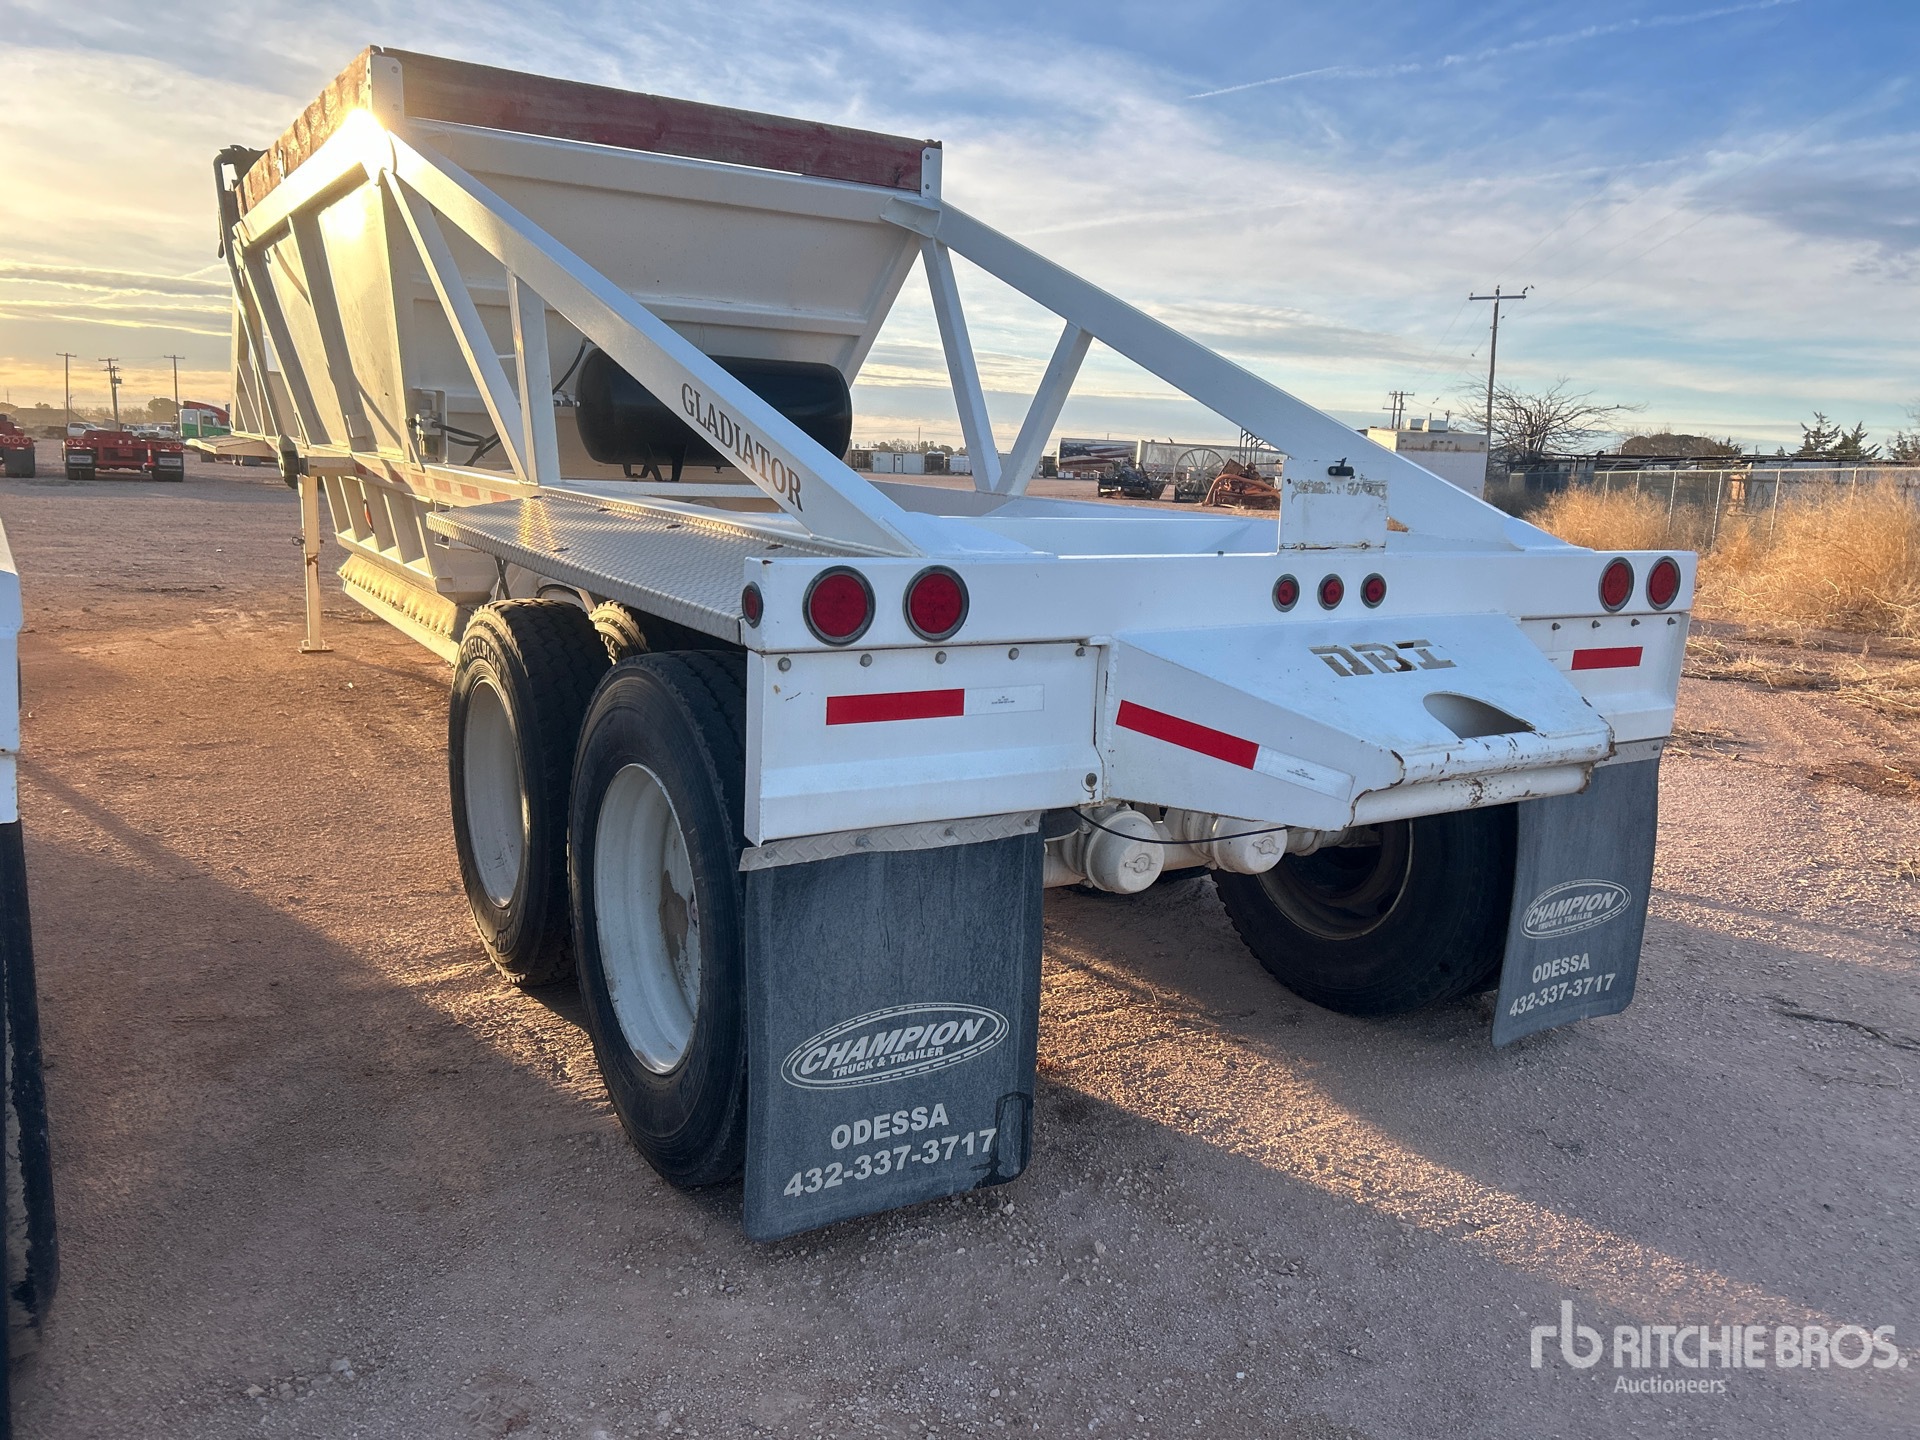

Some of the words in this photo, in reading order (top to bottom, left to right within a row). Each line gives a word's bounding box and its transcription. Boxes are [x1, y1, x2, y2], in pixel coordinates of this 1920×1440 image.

[681, 383, 803, 513] GLADIATOR
[1308, 638, 1457, 677] DBI
[1526, 891, 1619, 928] CHAMPION
[1537, 919, 1557, 931] TRUCK
[1563, 911, 1593, 924] TRAILER
[1532, 952, 1590, 984] ODESSA
[1509, 972, 1616, 1017] 432-337-3717
[800, 1017, 986, 1076] CHAMPION
[831, 1059, 875, 1079] TRUCK
[876, 1056, 887, 1067] &
[889, 1046, 945, 1066] TRAILER
[830, 1102, 950, 1150] ODESSA
[783, 1127, 997, 1198] 432-337-3717
